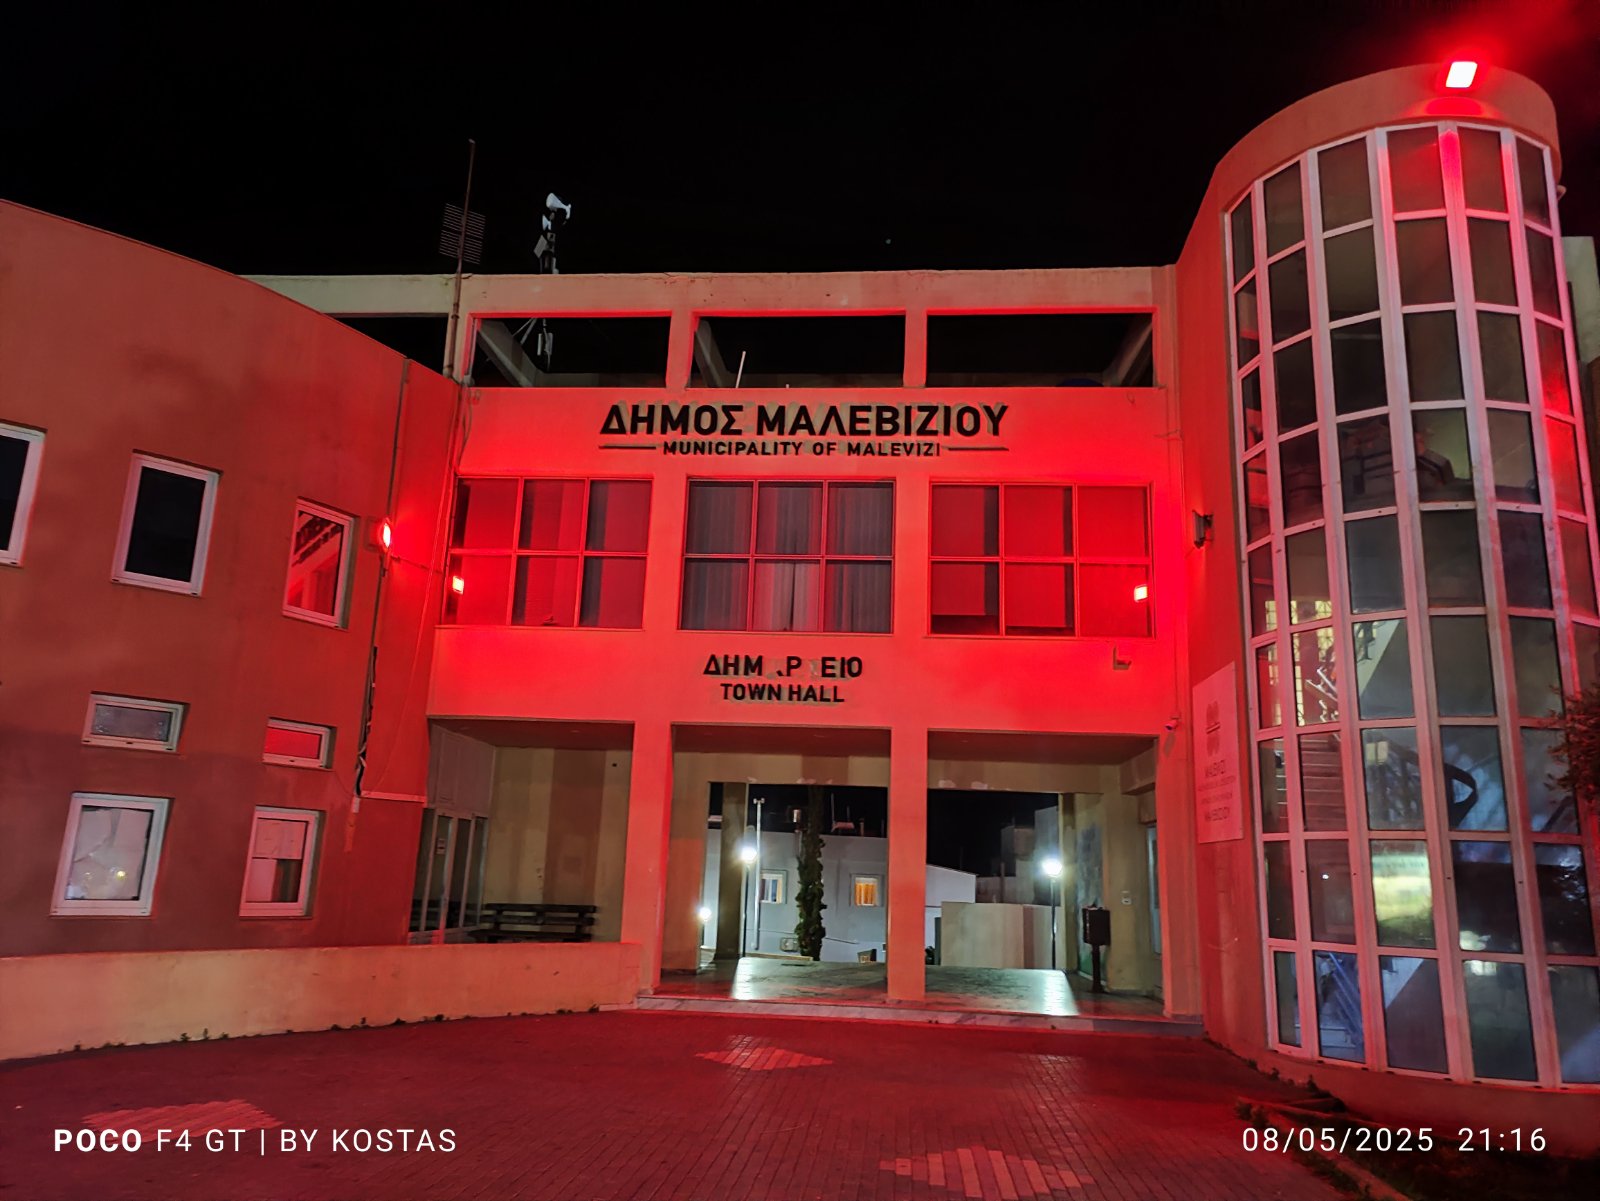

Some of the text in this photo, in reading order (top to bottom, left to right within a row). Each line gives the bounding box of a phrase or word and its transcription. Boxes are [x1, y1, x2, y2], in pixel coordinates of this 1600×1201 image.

[601, 405, 1007, 436] ΔΗΜΟΣ ΜΑΛΕΒΙΖΙΟΥ
[664, 441, 939, 456] MUNICIPALITY OF MALEVIZI
[721, 684, 844, 702] TOWN HALL
